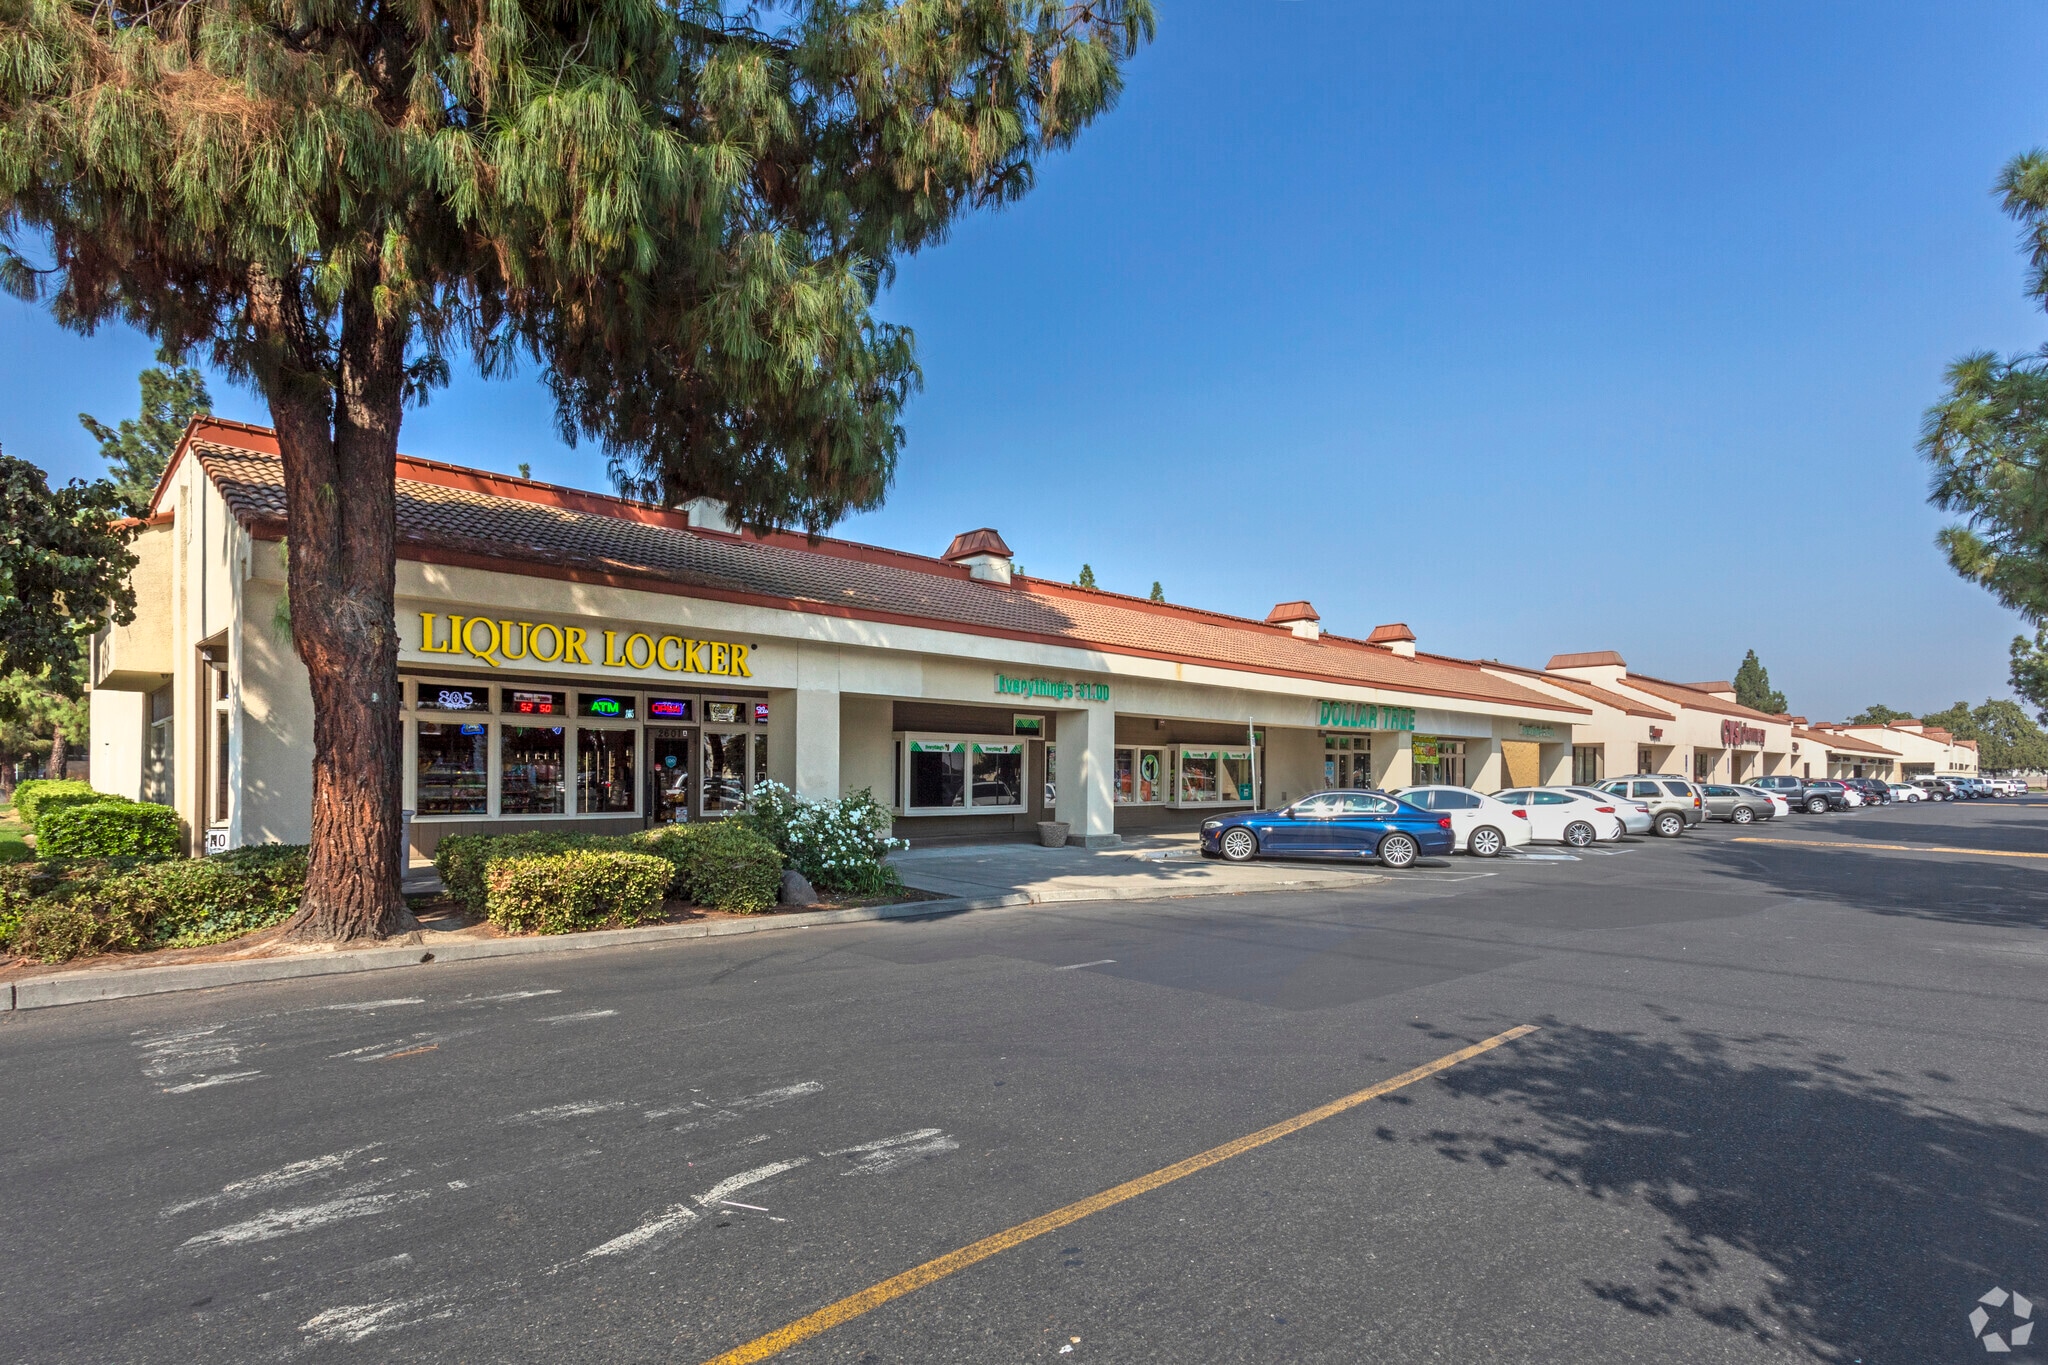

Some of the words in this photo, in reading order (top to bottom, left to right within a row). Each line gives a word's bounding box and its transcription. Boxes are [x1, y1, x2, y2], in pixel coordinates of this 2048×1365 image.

[419, 612, 592, 667] LIQUOR
[603, 630, 753, 677] LOCKER
[995, 674, 1074, 699] Everything's
[438, 690, 474, 705] 805
[520, 702, 533, 712] 52
[591, 701, 619, 713] ATM
[1319, 700, 1378, 729] DOLLAR
[1382, 706, 1416, 731] TREE
[658, 729, 681, 738] 2601
